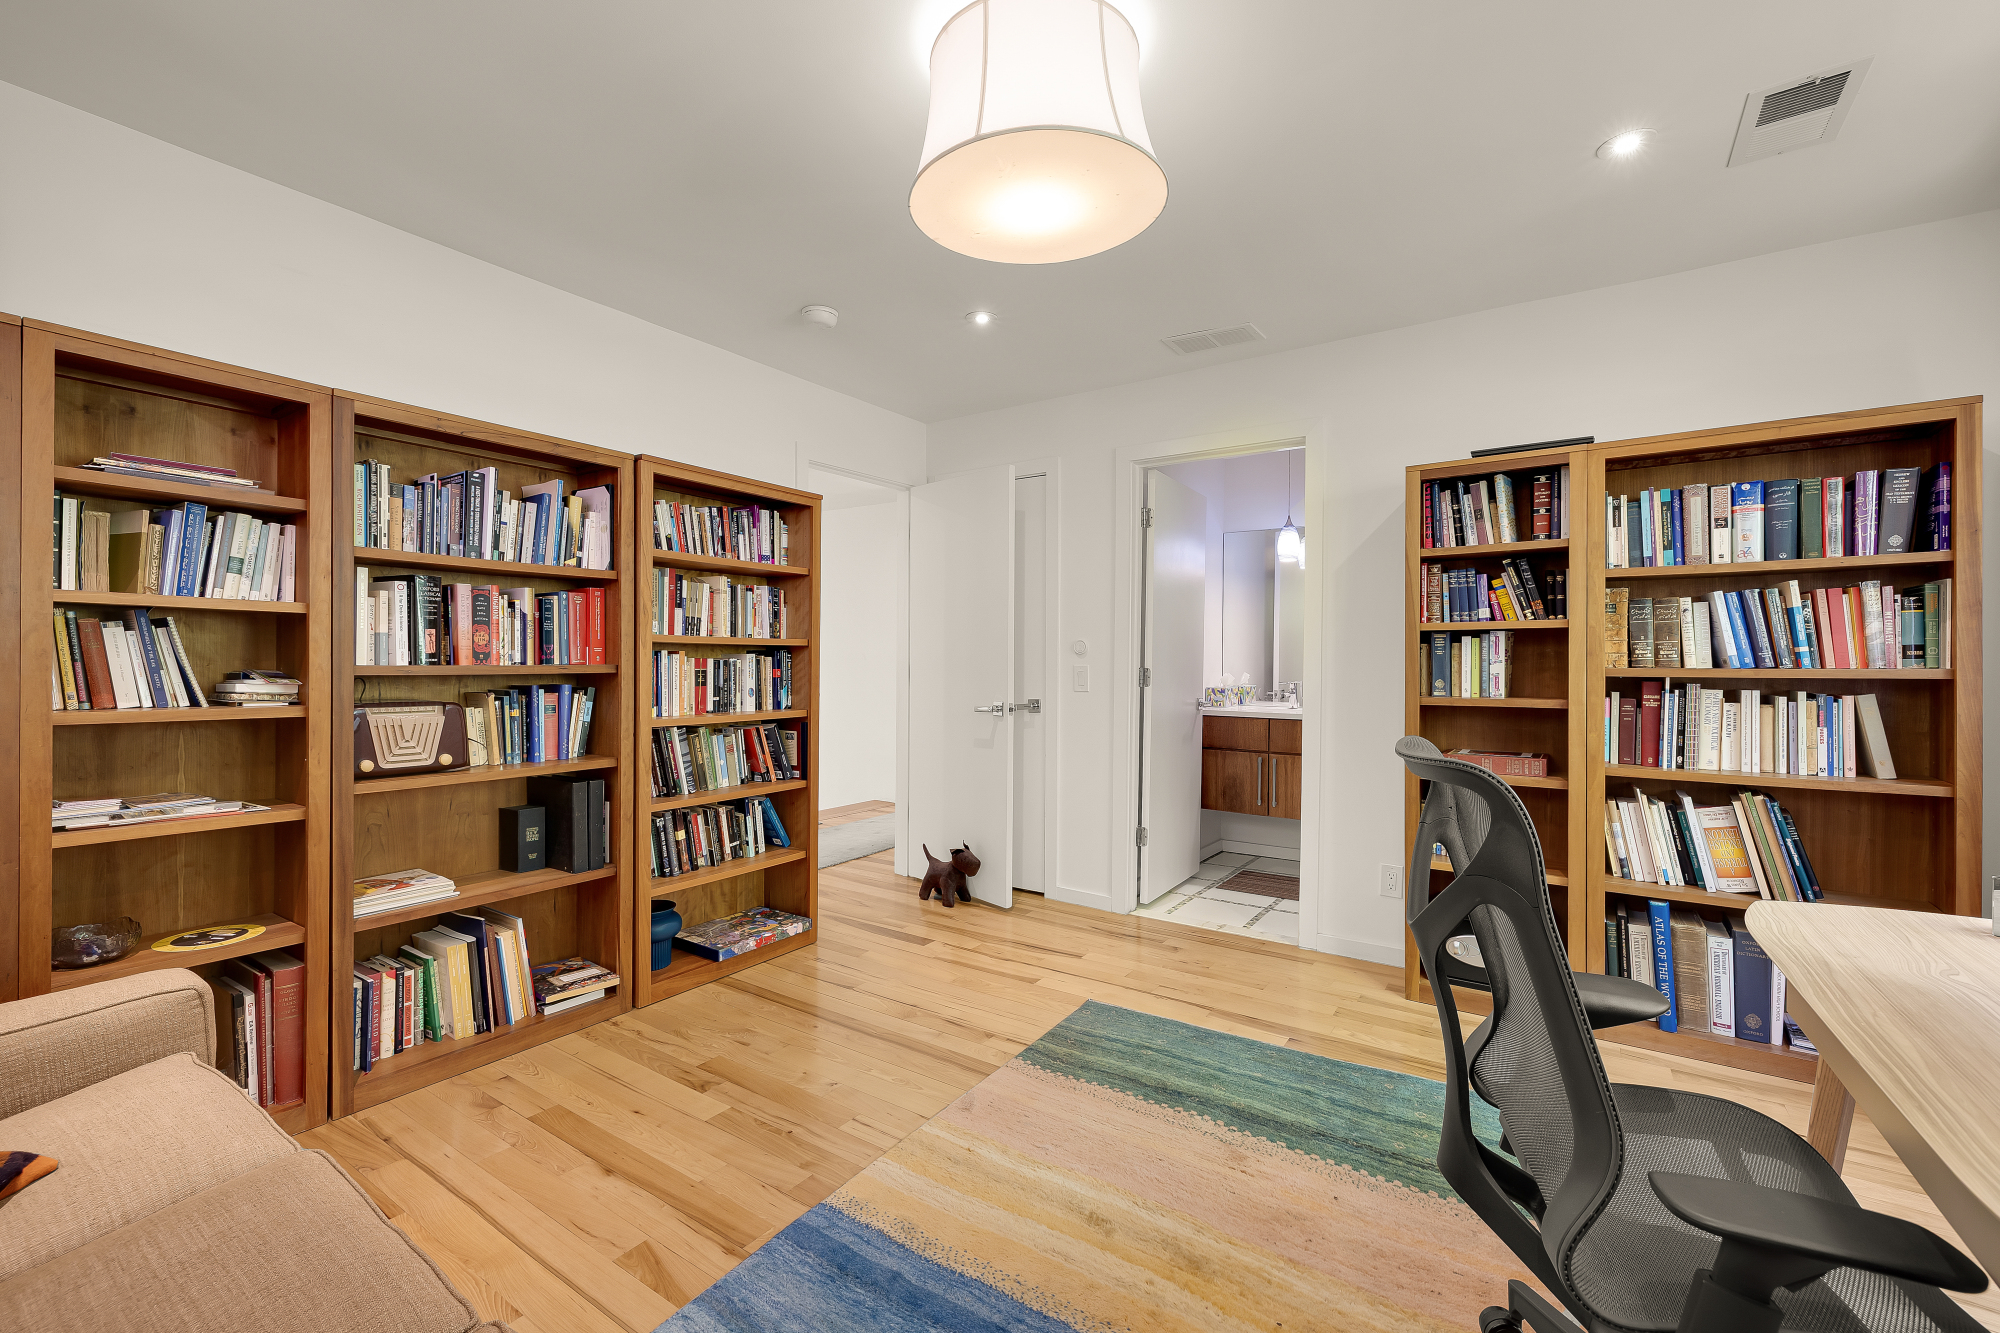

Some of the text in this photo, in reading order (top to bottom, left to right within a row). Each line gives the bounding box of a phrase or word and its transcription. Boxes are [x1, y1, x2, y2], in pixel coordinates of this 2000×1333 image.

[527, 620, 535, 640] KAFKA
[1702, 640, 1710, 654] LIFE
[1704, 692, 1712, 726] DICTIONARY
[1710, 726, 1718, 751] POLITICAL
[1704, 829, 1740, 838] LEXICON
[1705, 839, 1743, 850] ENGLISH
[1714, 858, 1748, 868] TURKISH
[1730, 868, 1735, 876] A
[1654, 916, 1665, 945] ATLAS
[1658, 947, 1666, 960] OF
[1658, 962, 1668, 980] THE
